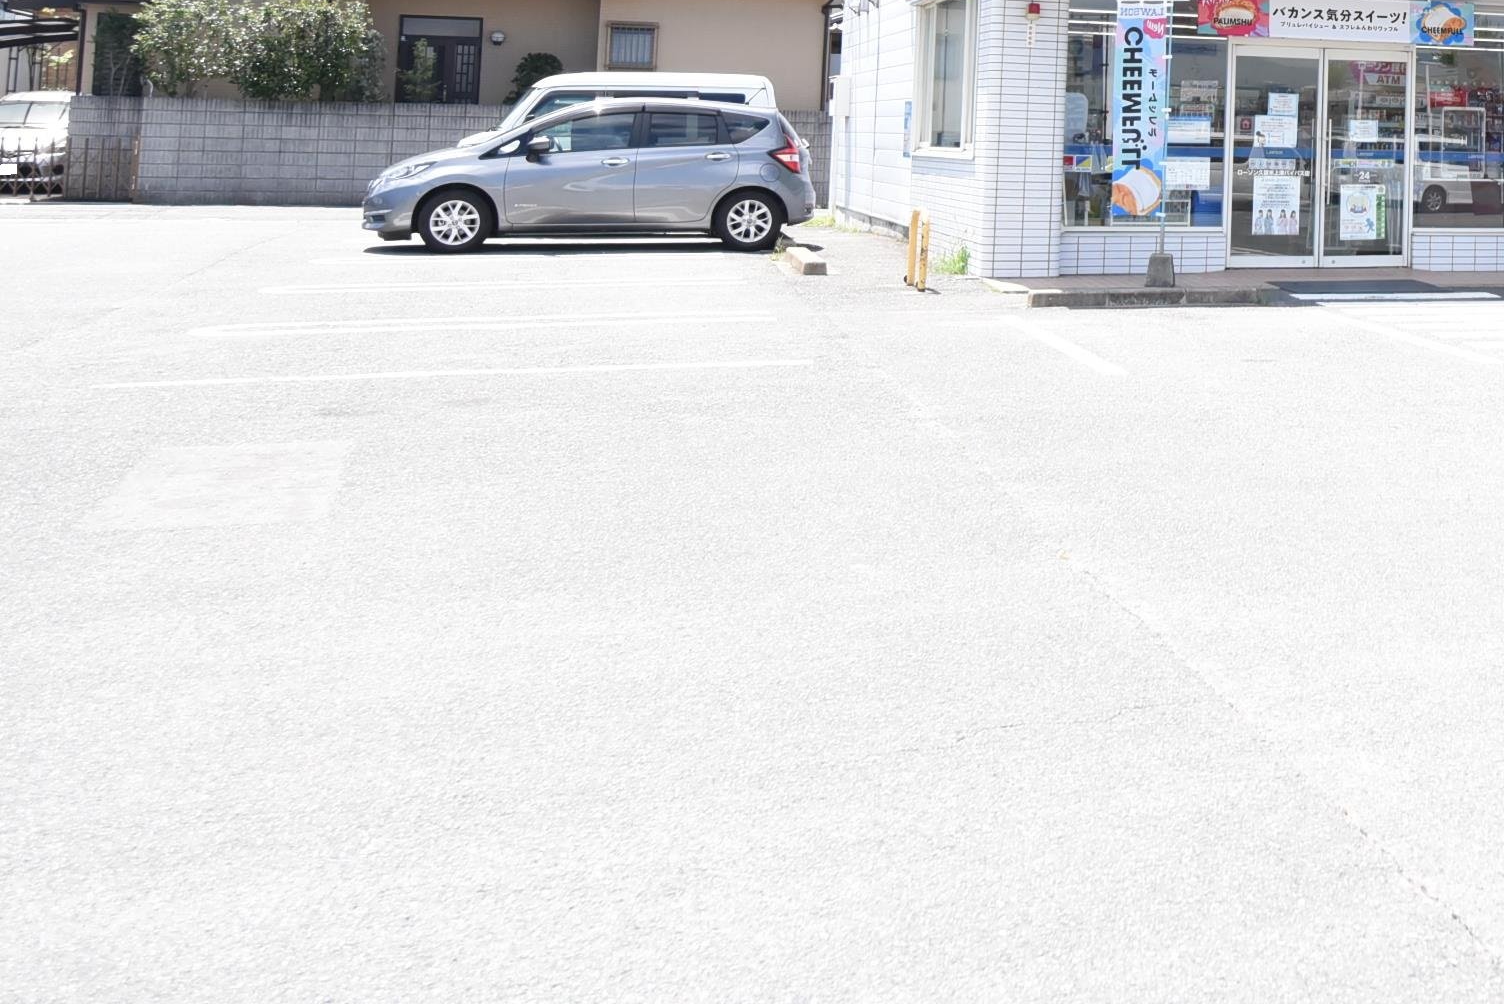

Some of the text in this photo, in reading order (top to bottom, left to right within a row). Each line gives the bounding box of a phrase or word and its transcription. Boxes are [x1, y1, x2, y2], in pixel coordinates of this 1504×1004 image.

[1273, 7, 1407, 25] バカンス気分スイーツ!
[1213, 17, 1253, 26] PALIMSHU
[1376, 76, 1401, 85] ATM
